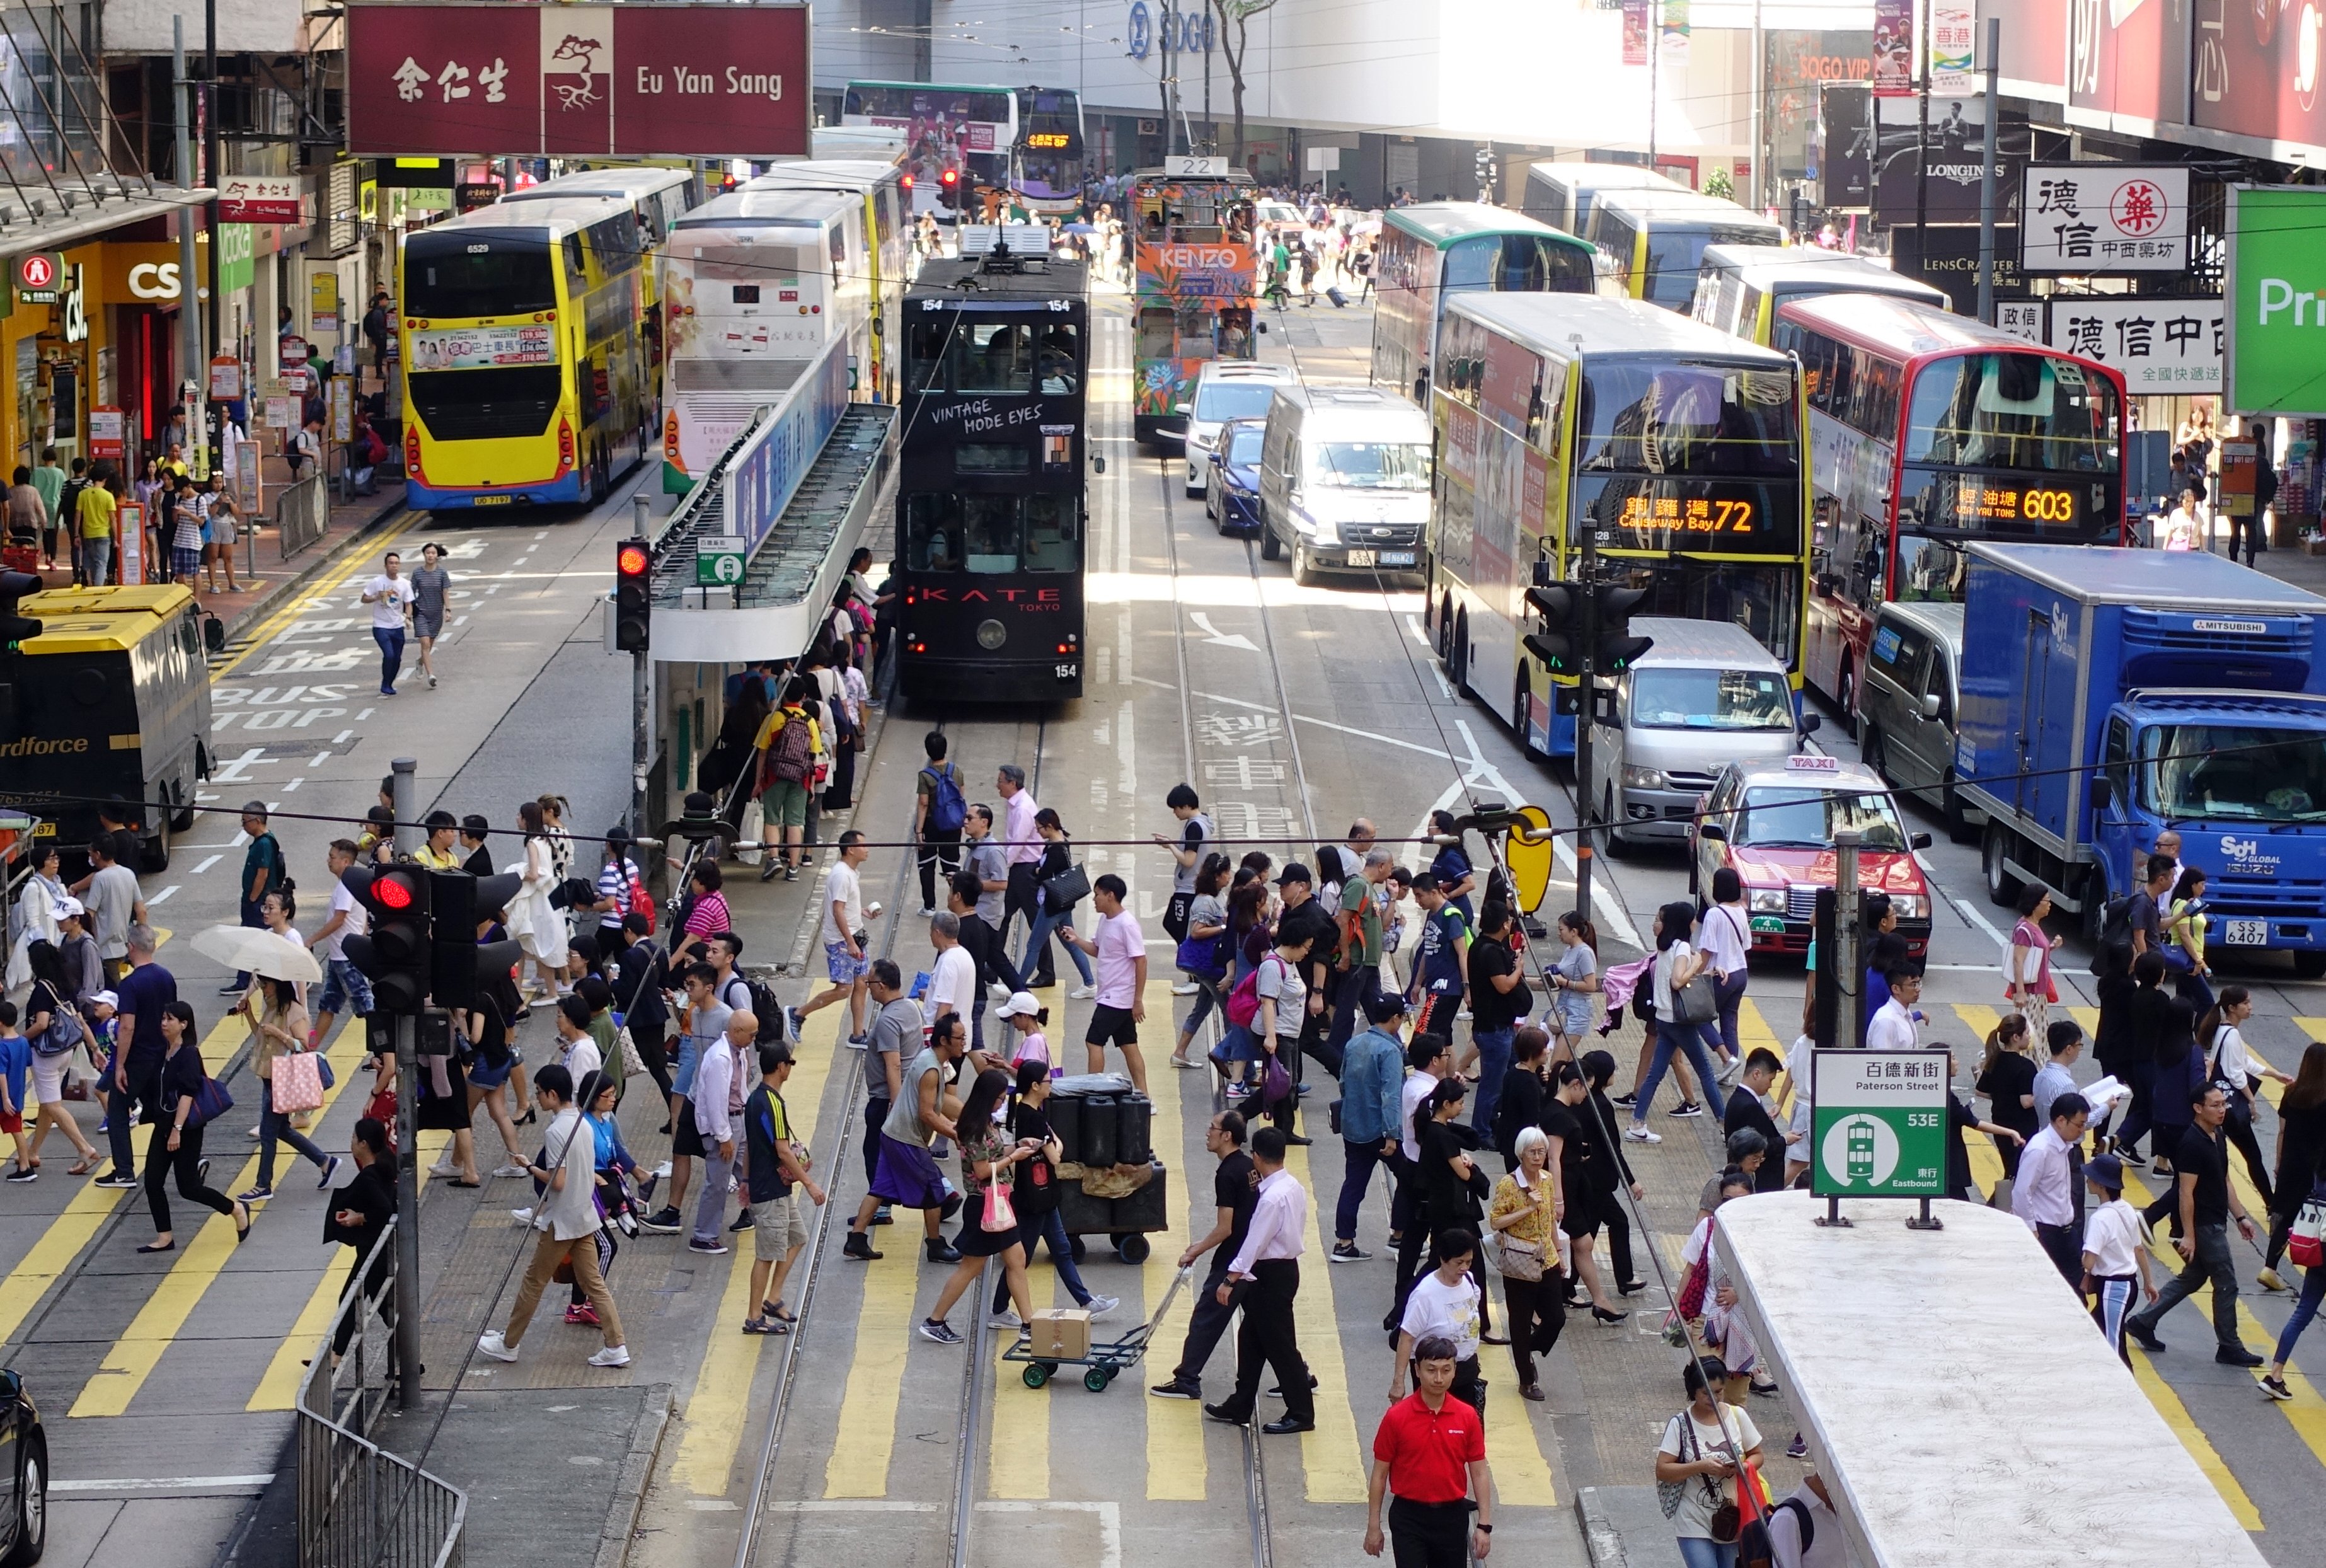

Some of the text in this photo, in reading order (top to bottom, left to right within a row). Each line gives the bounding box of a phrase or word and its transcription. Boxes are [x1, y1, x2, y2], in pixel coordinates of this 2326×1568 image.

[1937, 26, 1971, 43] 香港
[1800, 55, 1870, 80] SOGO VIP
[392, 56, 510, 103] 余仁生
[637, 66, 783, 101] Eu Yan Sang
[1183, 159, 1210, 174] 22
[1926, 164, 2006, 178] LONGINS
[1143, 188, 1252, 198] 22 22
[468, 244, 489, 254] 6529
[2100, 243, 2176, 260] 中西藥坊
[1160, 248, 1238, 268] KENZO
[128, 262, 209, 299] cs.
[921, 299, 1070, 312] 154 154
[2260, 278, 2326, 327] Pri
[931, 398, 992, 424] VINTAGE
[964, 404, 1043, 434] MODE EYES
[1976, 507, 1993, 517] YAU
[1994, 508, 2016, 518] TONG
[1983, 490, 2017, 507] 油塘
[2024, 490, 2072, 522] 603
[1626, 497, 1752, 533] 銅鑼灣 72
[1619, 514, 1714, 531] Causeway Bay
[922, 587, 1060, 601] KATE
[1019, 603, 1061, 611] TOKYO
[2206, 622, 2262, 632] MITSUBISHI
[1055, 664, 1076, 678] 154
[0, 735, 89, 757] rdforce
[1792, 758, 1834, 768] TAXI
[2247, 855, 2281, 865] GLOBAL
[2226, 863, 2274, 875] ISUZU
[2238, 922, 2256, 933] SS
[2228, 932, 2265, 944] 6407
[1866, 1061, 1939, 1078] 百德新街
[1856, 1081, 1939, 1091] Paterson Street
[1908, 1114, 1939, 1127] 53E
[1918, 1168, 1938, 1179] 東行
[1892, 1179, 1938, 1188] Eastbound
